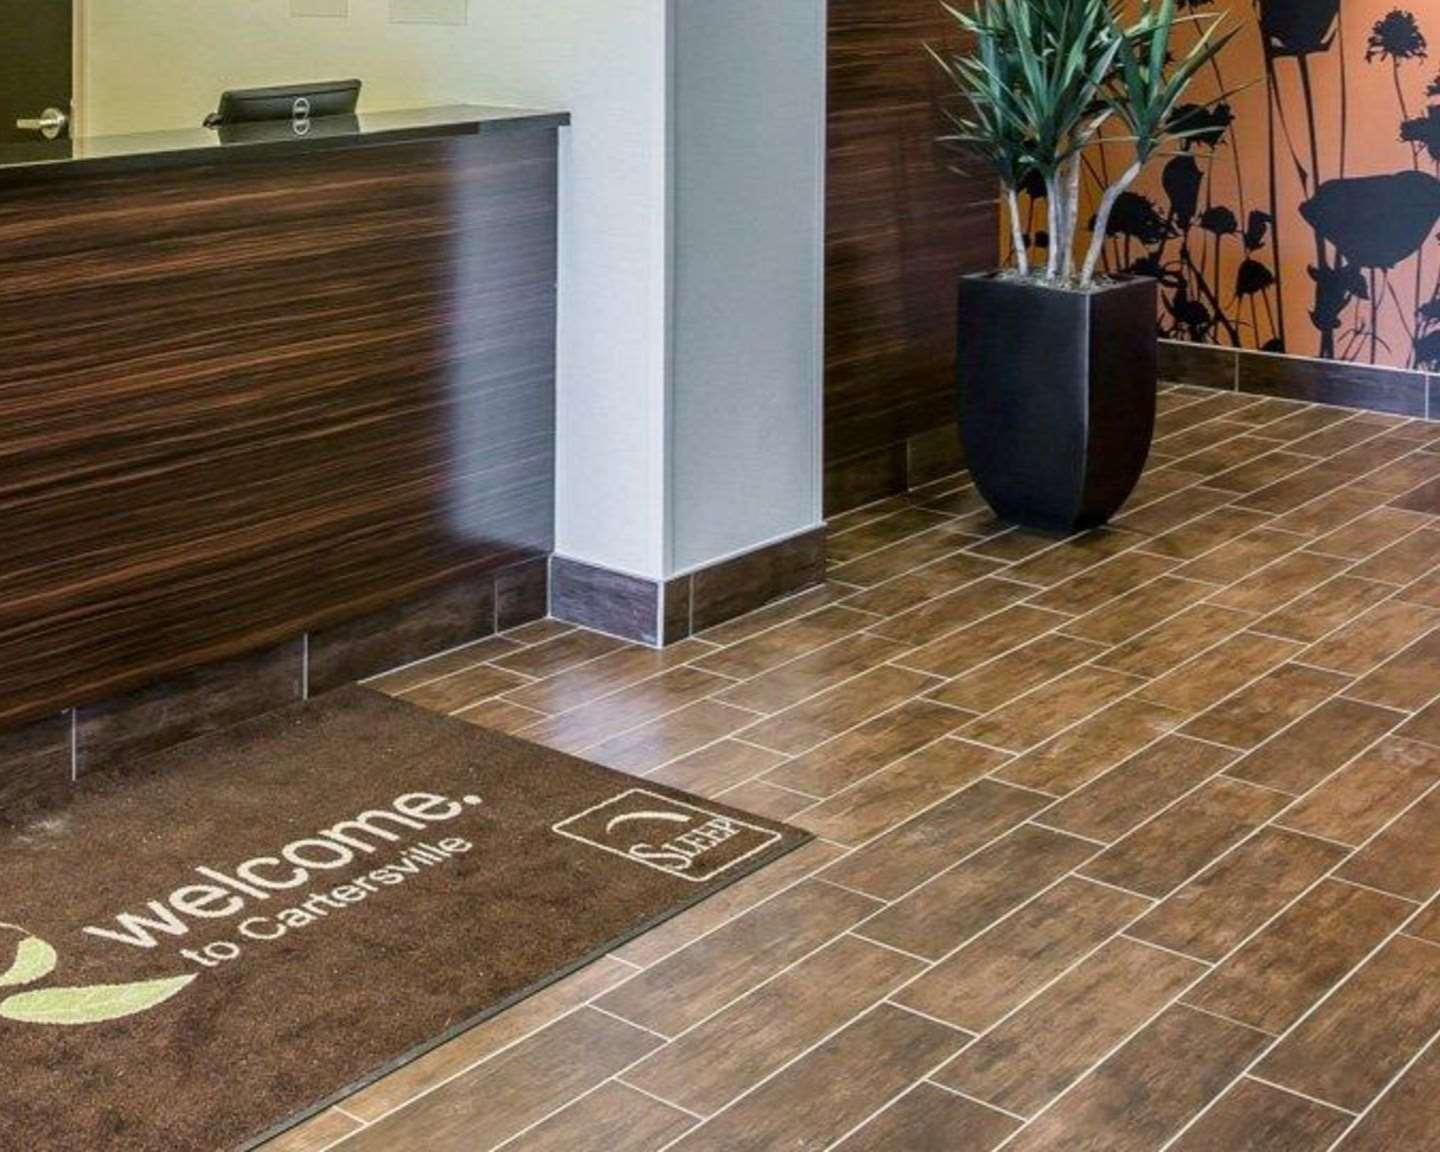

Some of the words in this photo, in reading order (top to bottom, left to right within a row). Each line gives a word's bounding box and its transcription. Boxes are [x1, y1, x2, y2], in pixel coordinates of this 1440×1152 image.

[82, 791, 482, 949] welcome.
[180, 940, 240, 968] to
[238, 836, 473, 941] Cartersville
[629, 814, 742, 870] SLEEP
